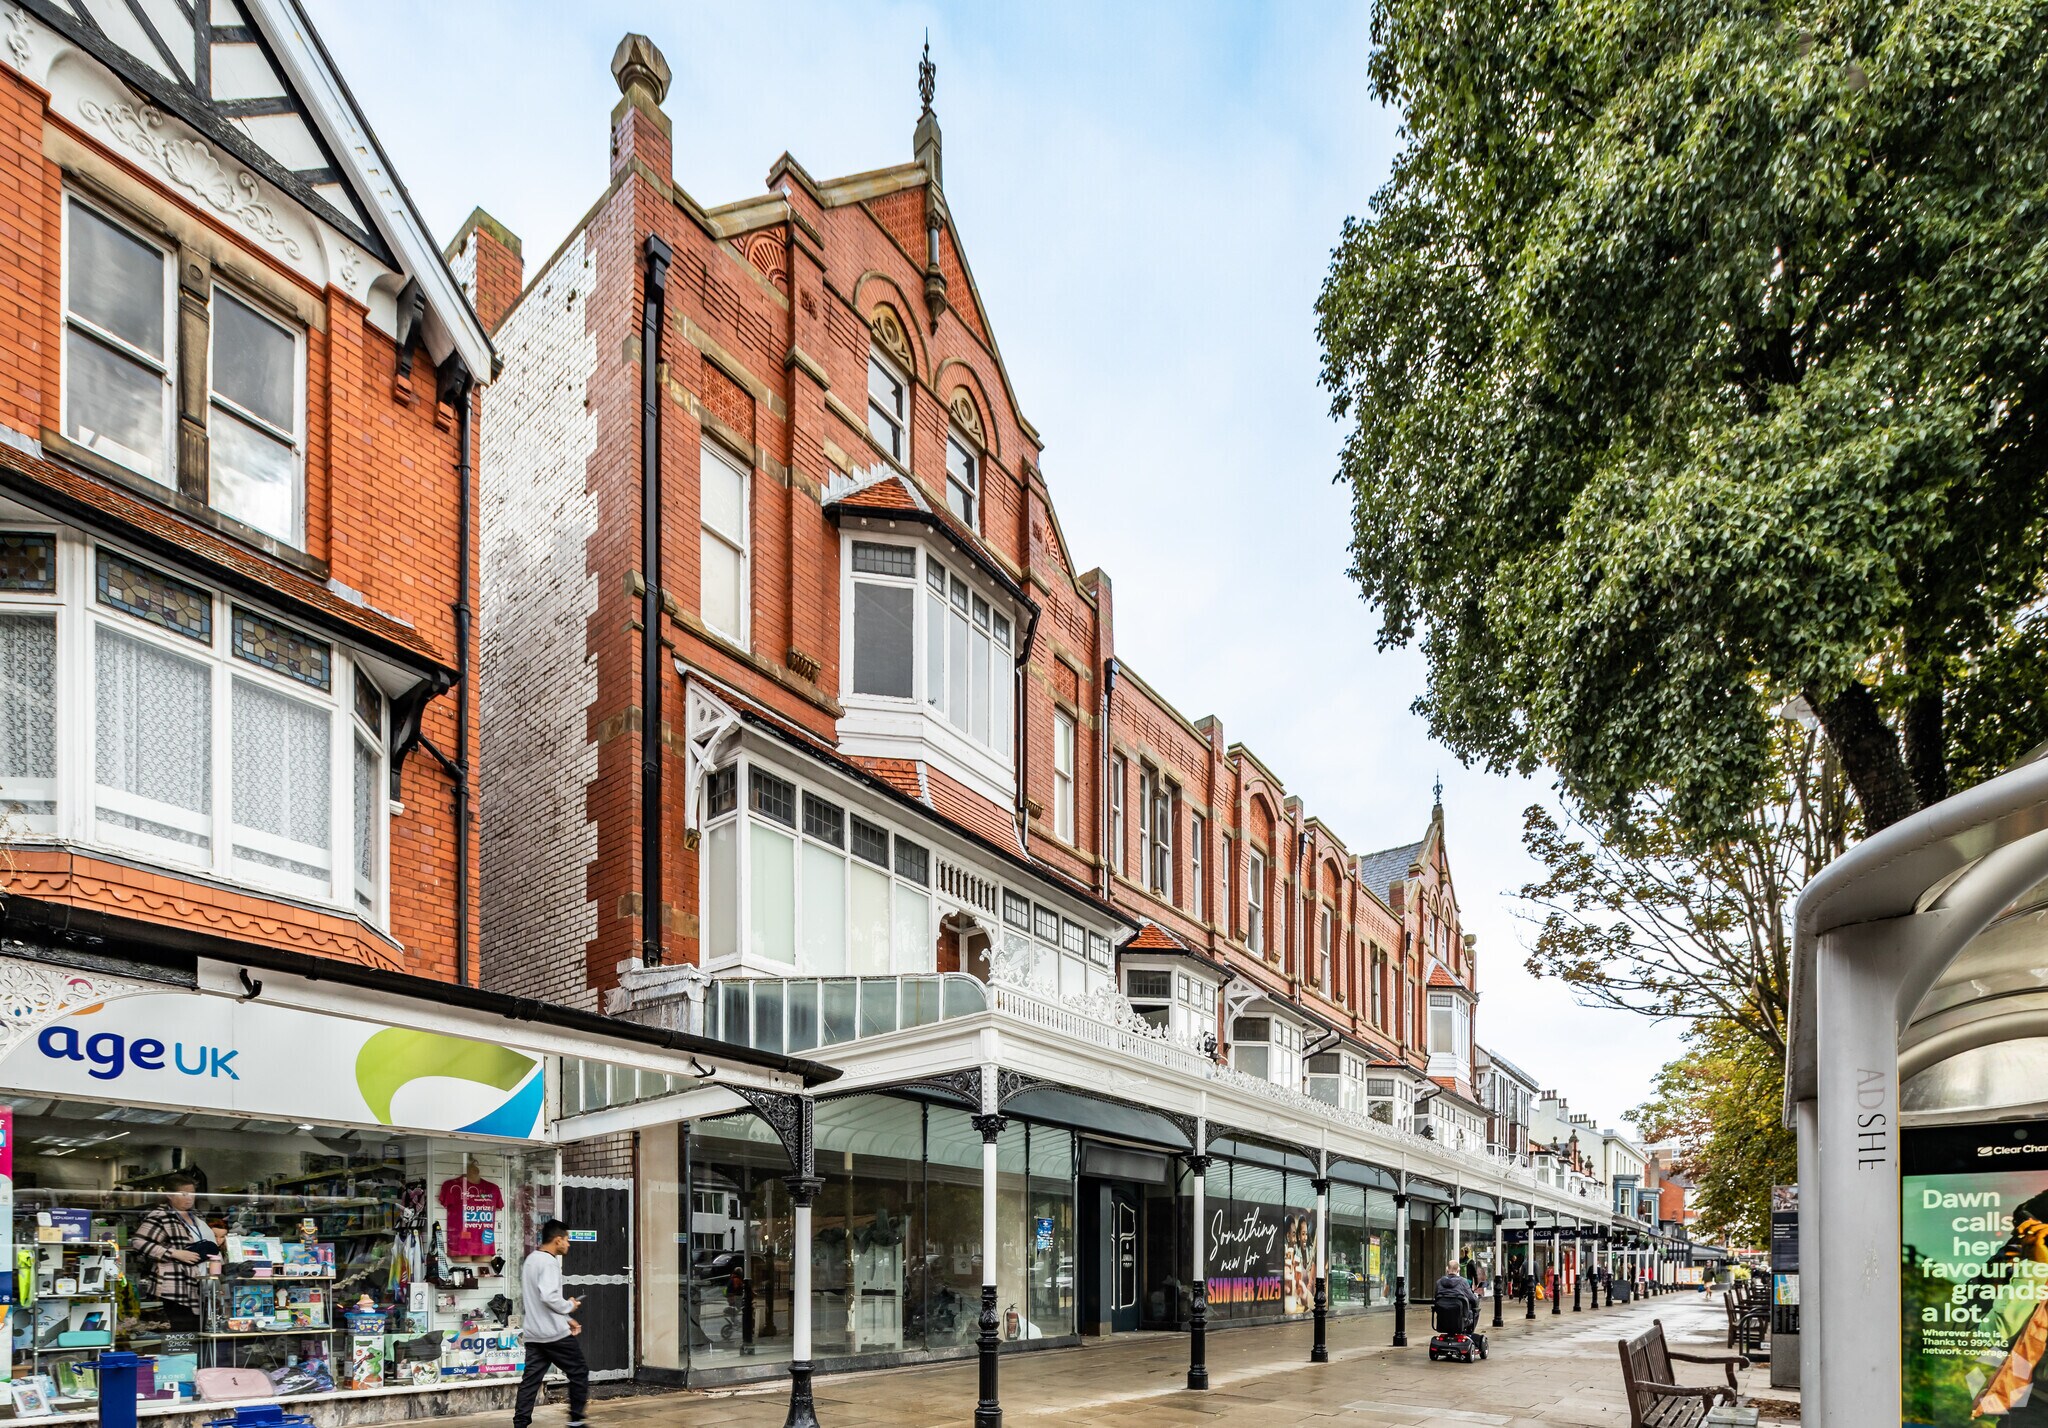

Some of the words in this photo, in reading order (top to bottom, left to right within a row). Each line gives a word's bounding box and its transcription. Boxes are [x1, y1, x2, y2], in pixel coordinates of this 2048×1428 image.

[37, 1025, 166, 1081] age
[174, 1042, 241, 1081] UK
[1993, 1146, 2022, 1155] Clear
[1923, 1189, 2000, 1209] Dawn
[464, 1211, 493, 1223] £2,00
[1951, 1211, 2014, 1232] calls
[1209, 1206, 1278, 1262] Something
[1953, 1236, 2004, 1256] her
[1220, 1256, 1241, 1272] new
[1243, 1245, 1260, 1274] for
[1922, 1257, 2048, 1278] favourite
[1256, 1276, 1282, 1301] 2025
[1951, 1280, 2048, 1304] grands
[1921, 1306, 1938, 1322] a
[1944, 1303, 1990, 1323] lot.
[460, 1337, 496, 1355] age
[497, 1332, 519, 1349] UK
[1922, 1329, 1971, 1338] Wherever
[1922, 1338, 1956, 1346] Thanks
[1970, 1340, 1993, 1348] 99%
[1963, 1349, 2011, 1359] coverage.
